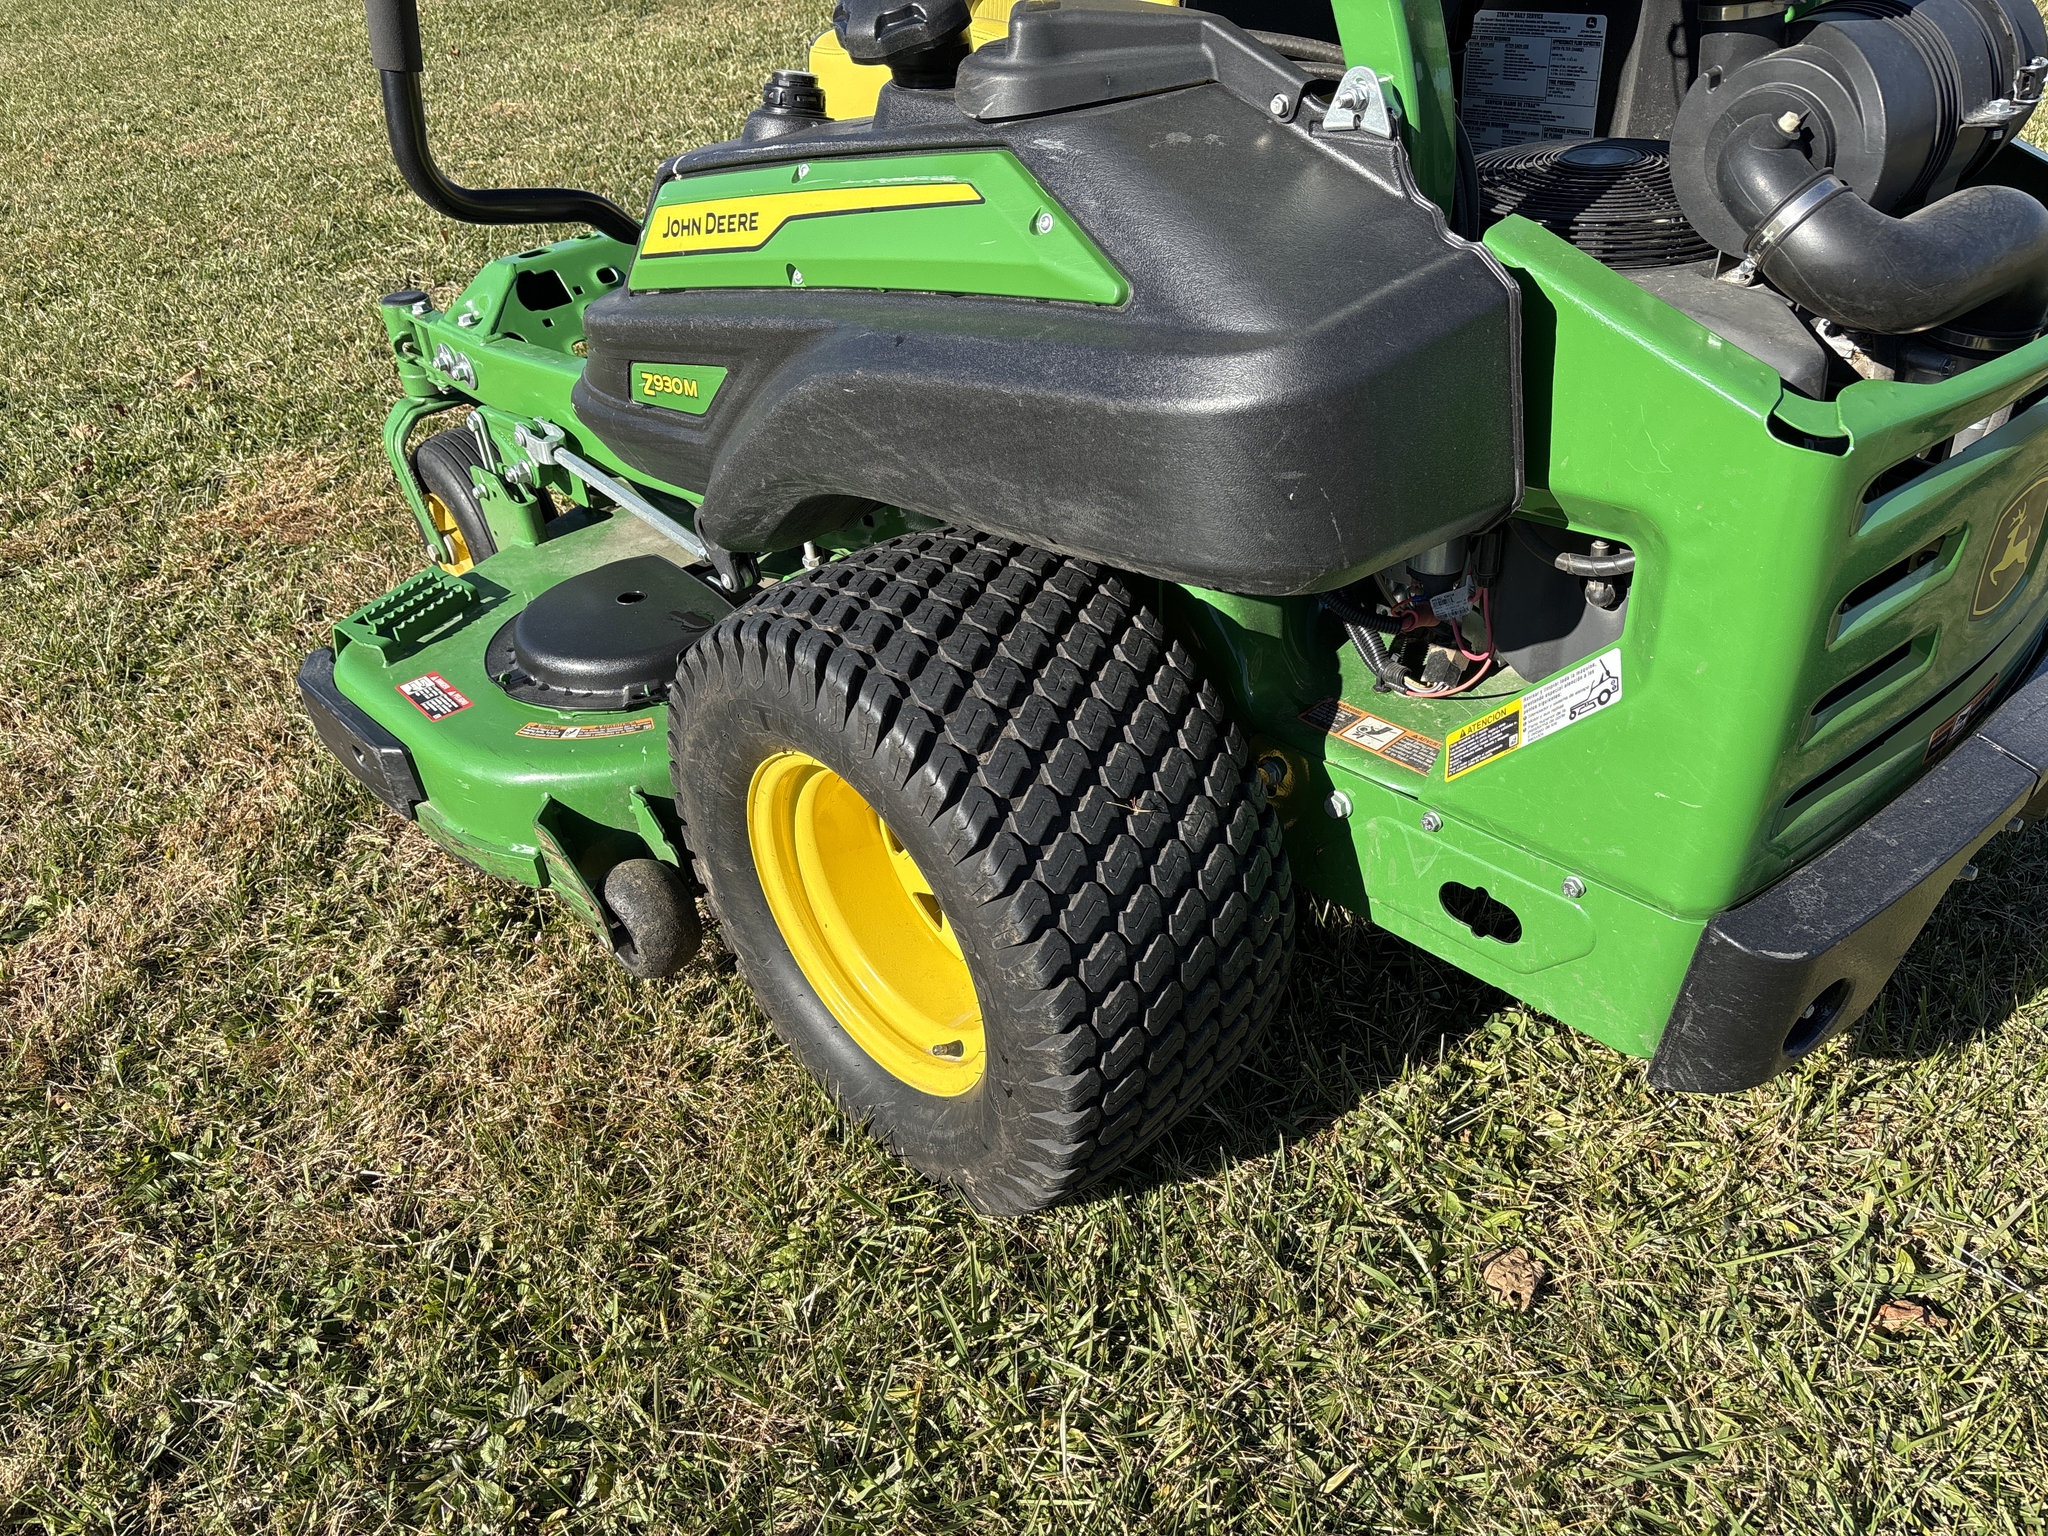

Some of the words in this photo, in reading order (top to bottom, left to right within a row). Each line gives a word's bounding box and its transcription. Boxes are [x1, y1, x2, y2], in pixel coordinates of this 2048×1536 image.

[662, 216, 701, 238] JOHN
[705, 212, 759, 234] DEERE
[640, 371, 699, 398] Z930M
